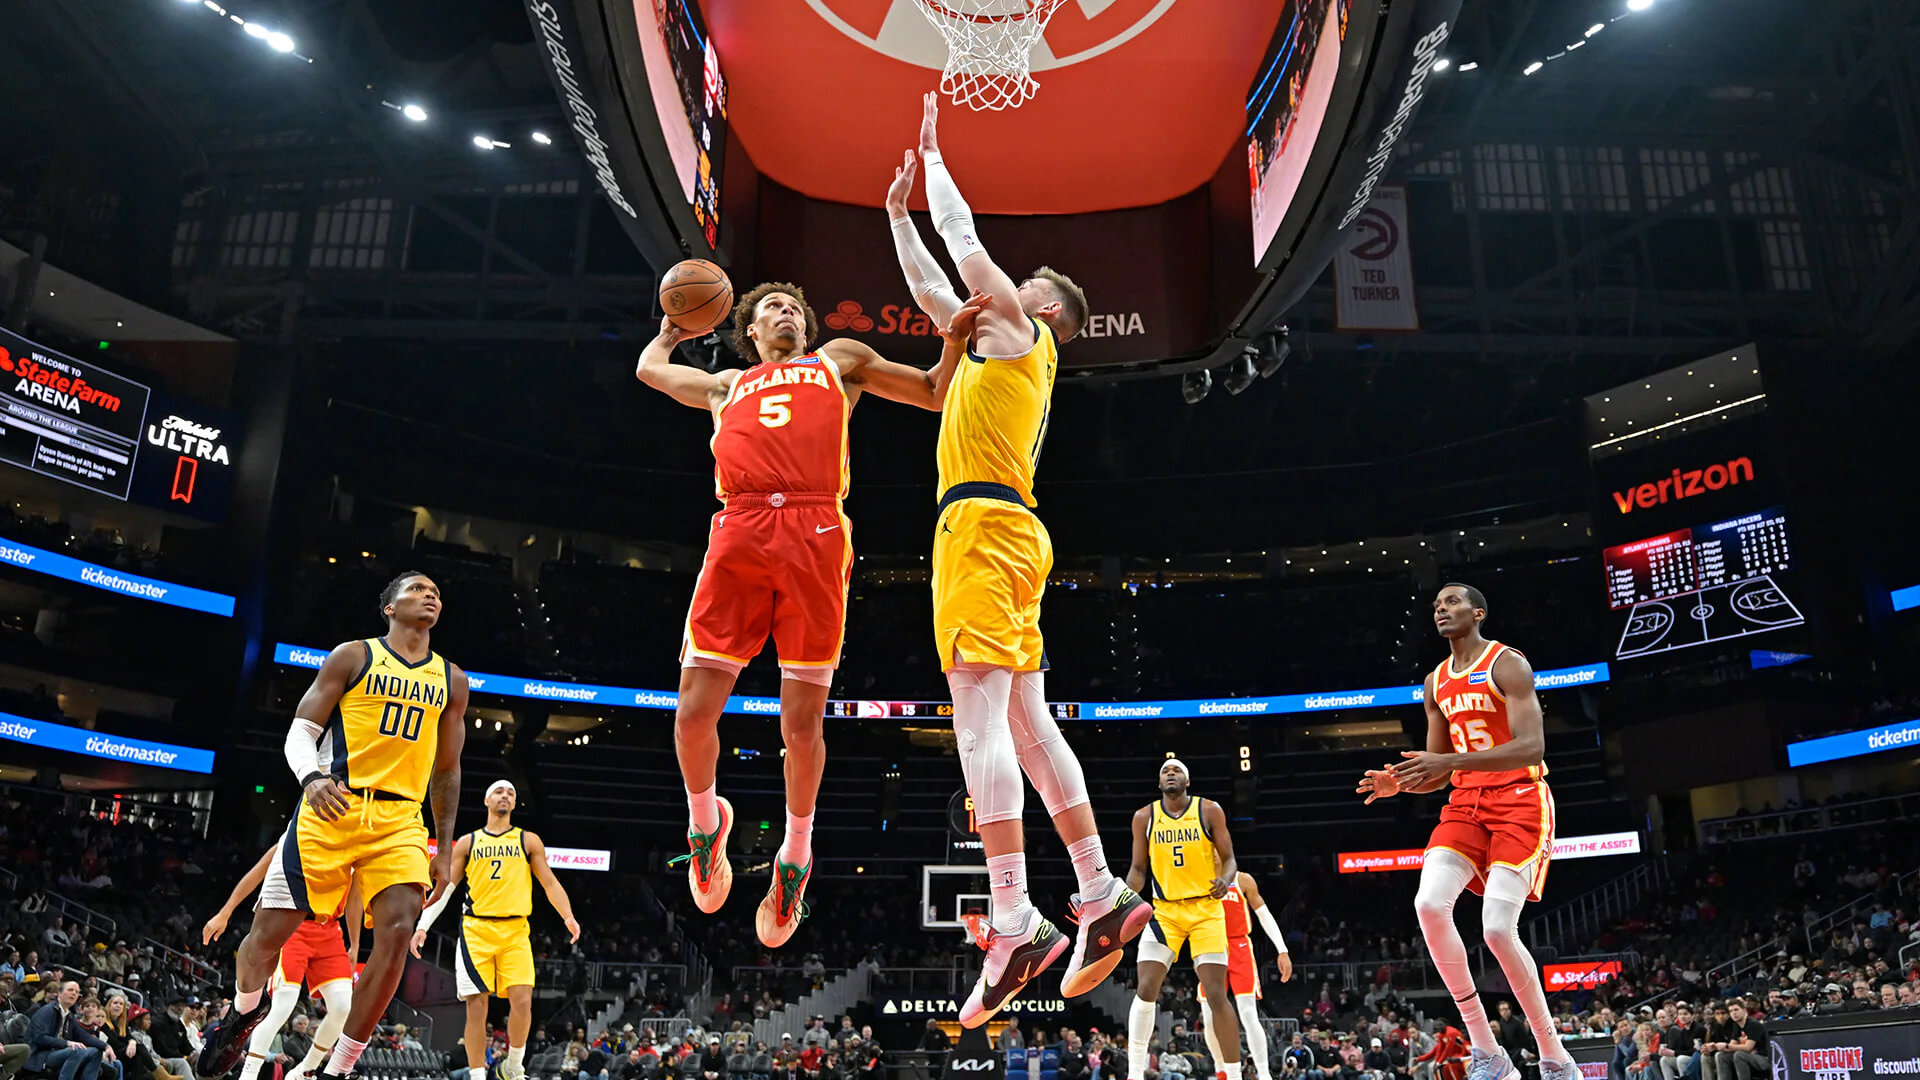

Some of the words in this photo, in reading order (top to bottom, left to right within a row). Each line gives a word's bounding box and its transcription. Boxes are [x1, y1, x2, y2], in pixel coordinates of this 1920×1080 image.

[1362, 269, 1385, 283] TED
[1352, 286, 1400, 300] TURNER
[878, 304, 941, 336] Sta
[31, 352, 70, 373] WELCOME
[71, 367, 82, 377] TO
[732, 367, 830, 406] ATLANTA
[15, 378, 80, 414] ARENA
[758, 393, 792, 428] 5
[8, 404, 38, 420] AROUND
[38, 414, 52, 426] THE
[52, 419, 78, 435] LEAGUE
[147, 424, 230, 466] ULTRA
[1612, 456, 1755, 515] verizon
[1712, 520, 1738, 532] INDIANA
[1738, 514, 1762, 525] PACERS
[1623, 542, 1649, 554] ATLANTA
[1648, 537, 1670, 547] HAWKS
[1702, 540, 1721, 549] Player
[1703, 547, 1722, 556] Player
[1704, 554, 1723, 563] Player
[1705, 562, 1724, 570] Player
[1615, 568, 1632, 577] Player
[1616, 575, 1633, 584] Player
[1707, 569, 1725, 577] Player
[81, 567, 168, 599] ticketmaster
[1617, 582, 1634, 590] Player
[1618, 589, 1635, 598] Player
[365, 673, 444, 709] INDIANA
[524, 682, 598, 700] ticketmaster
[1199, 702, 1268, 714] ticketmaster
[1304, 694, 1375, 709] ticketmaster
[901, 704, 916, 716] 13
[1095, 705, 1163, 717] ticketmaster
[379, 701, 425, 742] 00
[1450, 719, 1495, 754] 35
[85, 736, 178, 764] ticketmaster
[1154, 828, 1200, 844] INDIANA
[473, 845, 520, 861] INDIANA
[1579, 843, 1598, 852] THE
[1600, 839, 1634, 850] ASSIST
[552, 855, 569, 864] THE
[572, 856, 605, 865] ASSIST
[1173, 845, 1184, 867] 5
[1397, 855, 1424, 865] WITH
[490, 860, 501, 880] 2
[902, 1000, 958, 1012] DELTA
[1801, 1048, 1863, 1071] DISCOUNT
